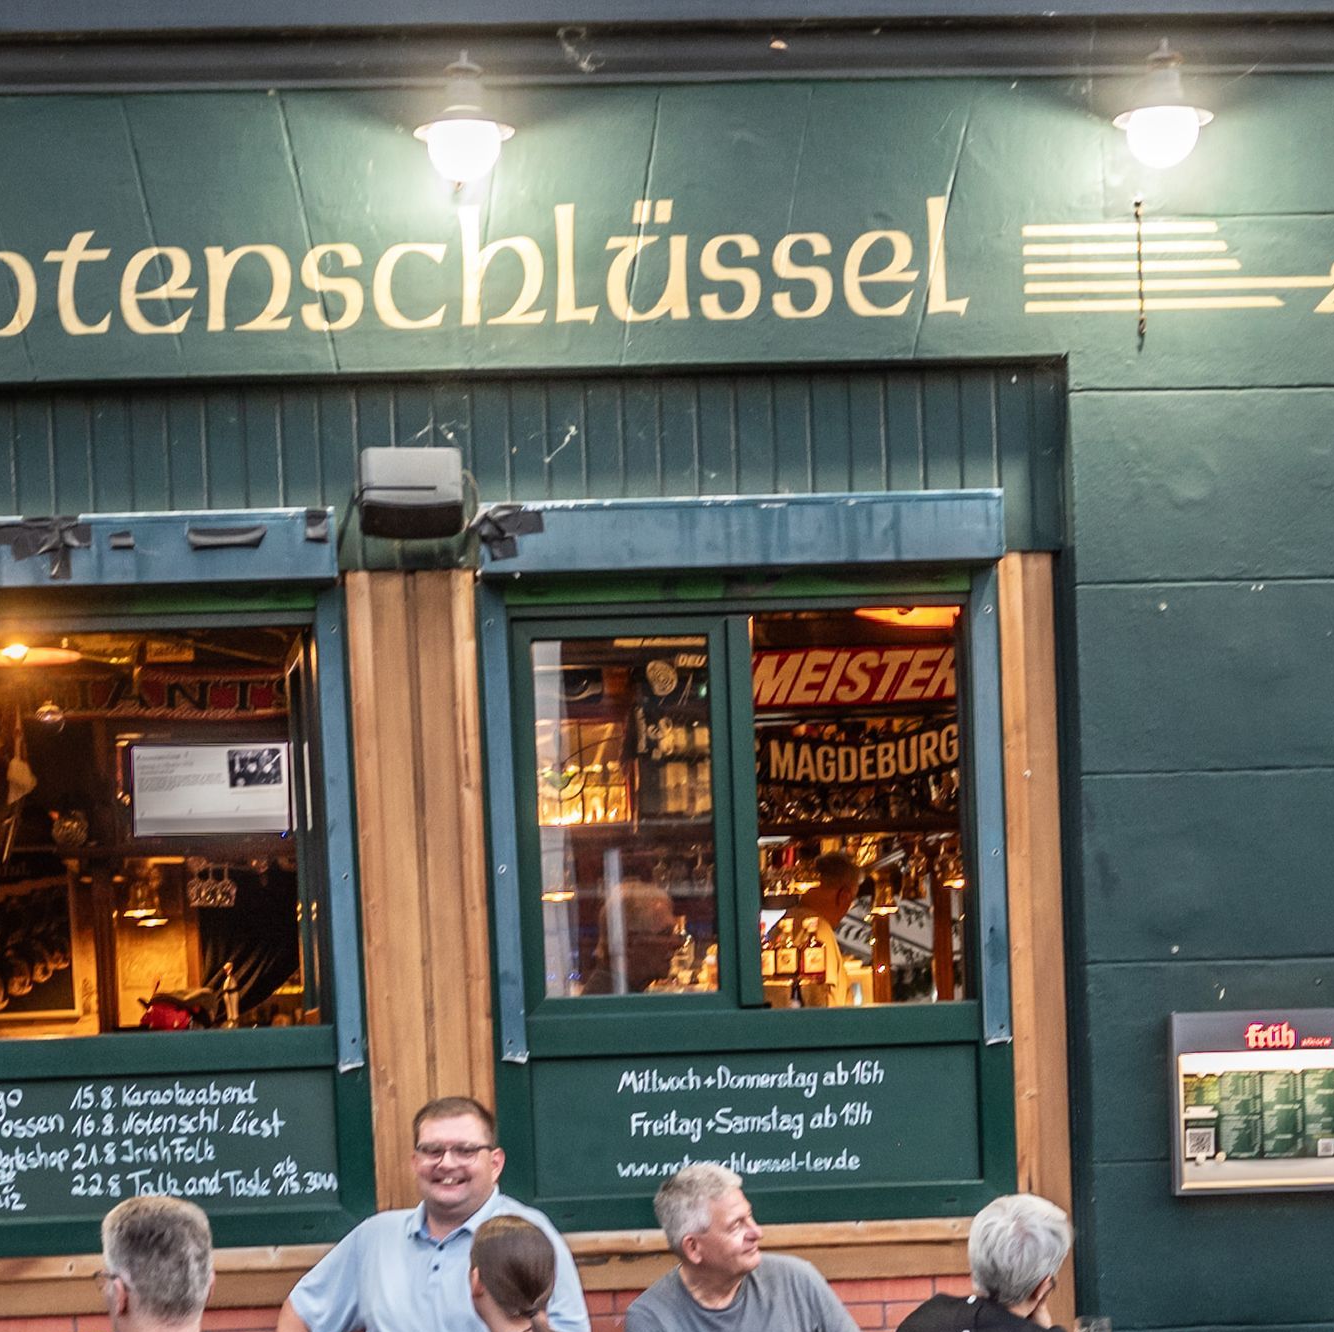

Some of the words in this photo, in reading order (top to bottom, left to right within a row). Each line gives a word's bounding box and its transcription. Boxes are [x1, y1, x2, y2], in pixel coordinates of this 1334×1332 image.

[769, 723, 960, 783] MAGDEBURG
[1244, 1020, 1297, 1049] früh
[121, 1079, 259, 1107] Karaokeabend
[617, 1067, 701, 1093] Mittwoch
[717, 1063, 817, 1098] Donnerstag
[822, 1061, 849, 1087] ab
[850, 1060, 885, 1086] 16h
[630, 1109, 702, 1143] Freitag
[714, 1105, 804, 1140] Samstag
[809, 1103, 837, 1130] ab
[836, 1101, 873, 1127] 19h
[272, 1154, 298, 1179] ab
[126, 1168, 183, 1197] Talk
[184, 1169, 223, 1197] and
